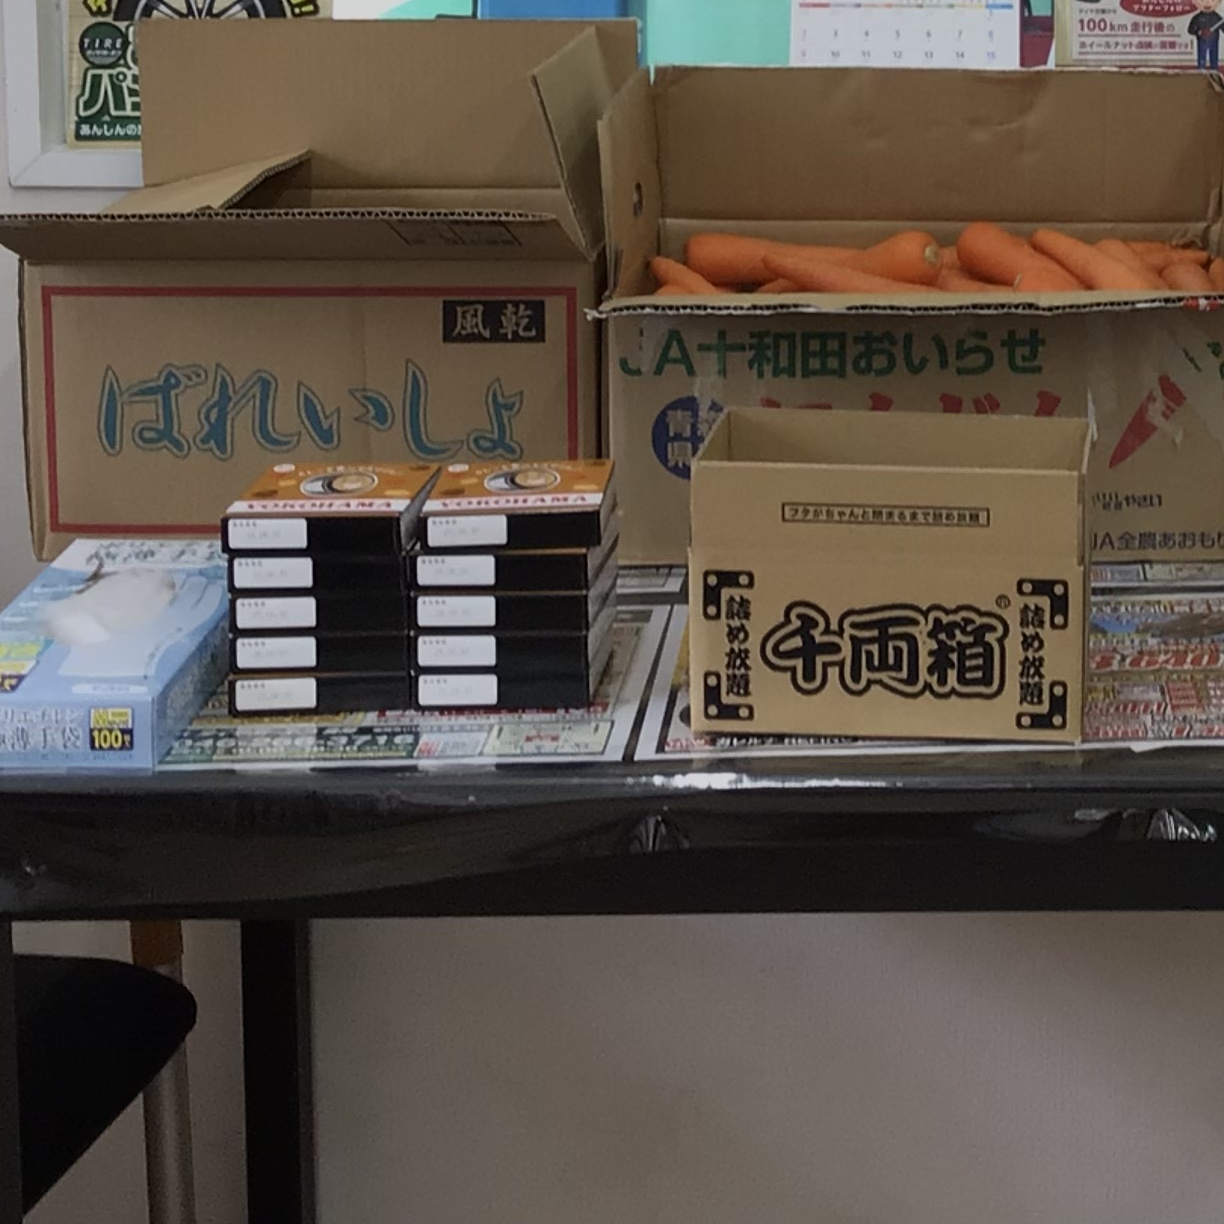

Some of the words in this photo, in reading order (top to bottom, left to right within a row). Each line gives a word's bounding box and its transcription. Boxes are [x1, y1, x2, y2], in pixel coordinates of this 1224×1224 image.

[83, 38, 122, 49] TIRE
[451, 303, 536, 339] 風乾
[725, 596, 751, 697] 詰め放題
[762, 602, 1008, 698] 千両箱
[1019, 604, 1045, 705] 詰め放題
